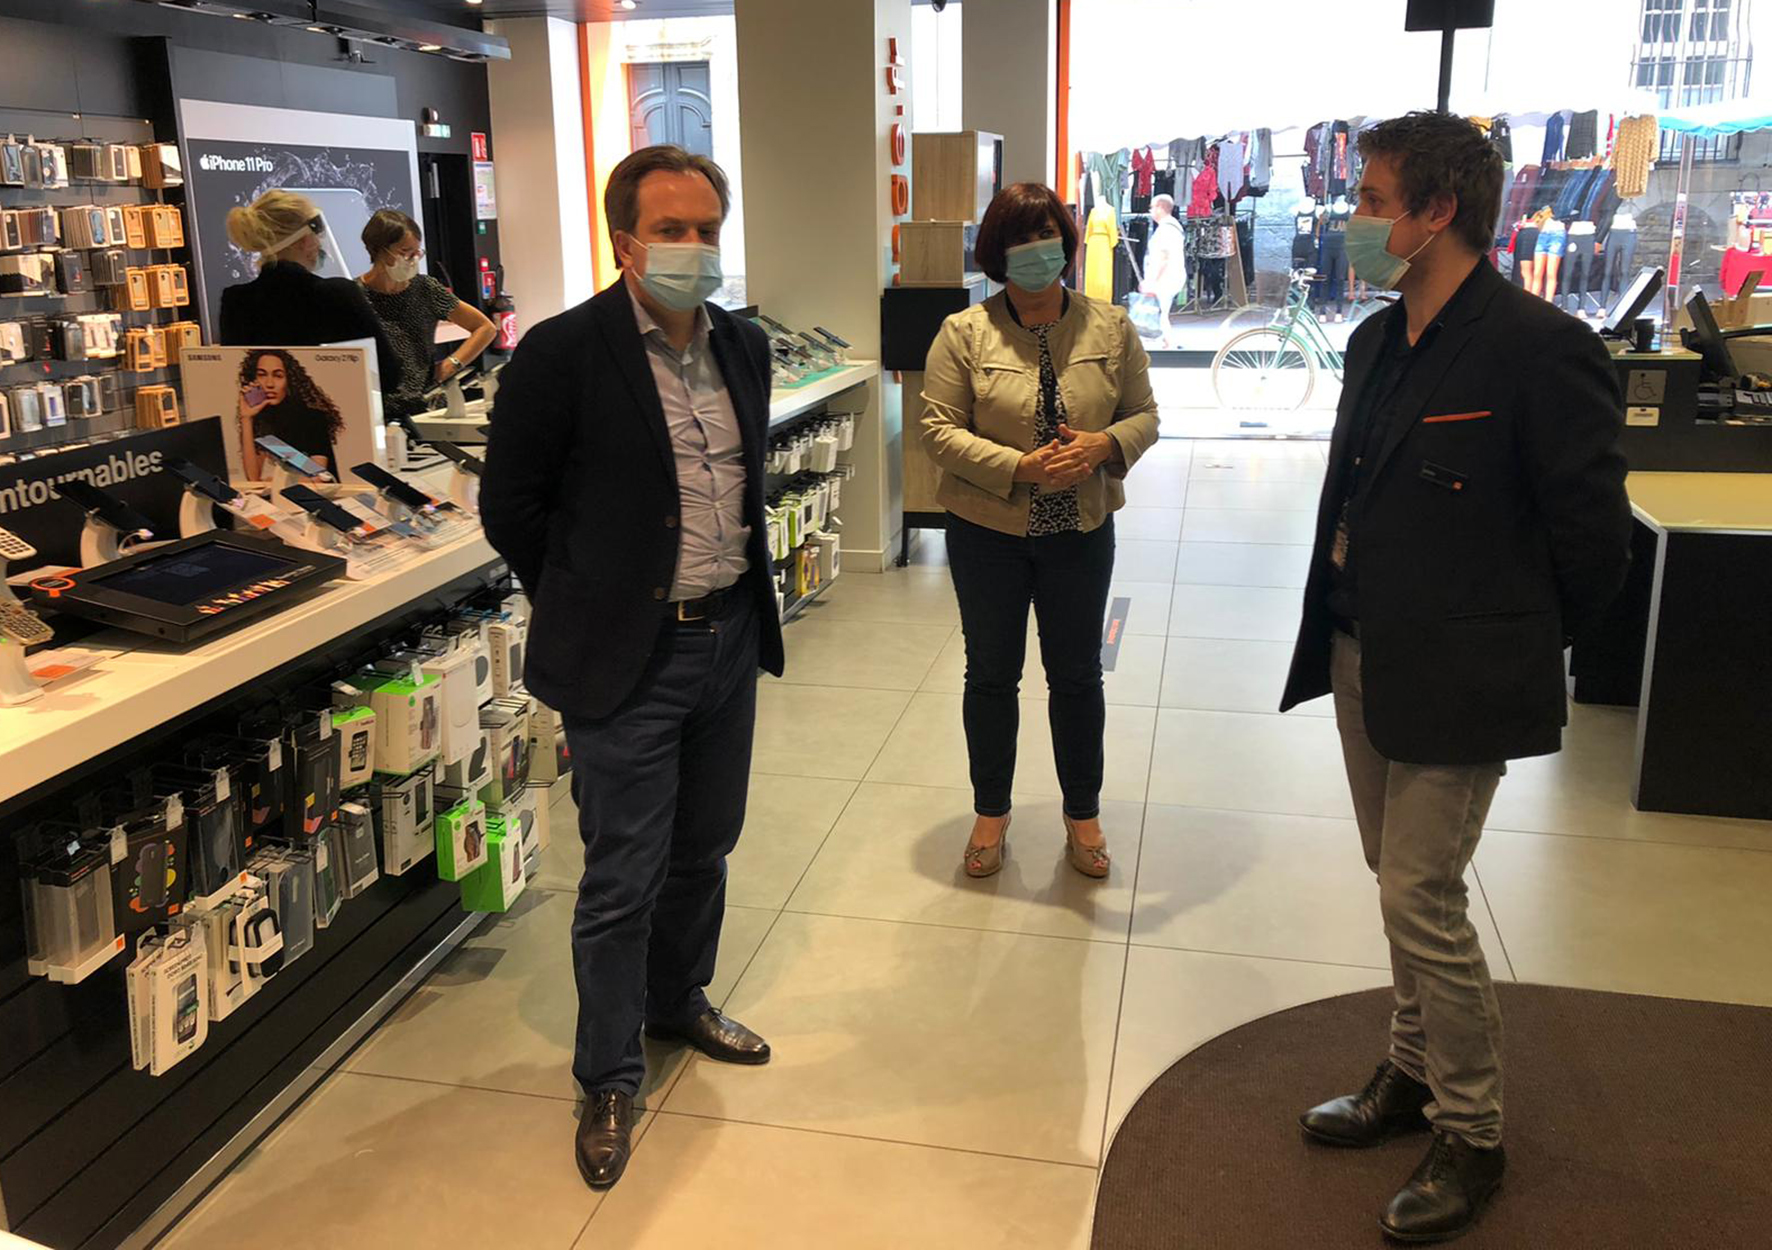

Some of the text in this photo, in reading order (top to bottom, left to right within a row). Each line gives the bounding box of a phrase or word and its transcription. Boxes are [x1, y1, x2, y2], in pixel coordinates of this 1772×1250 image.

[208, 154, 274, 172] iPhone 11 Pro
